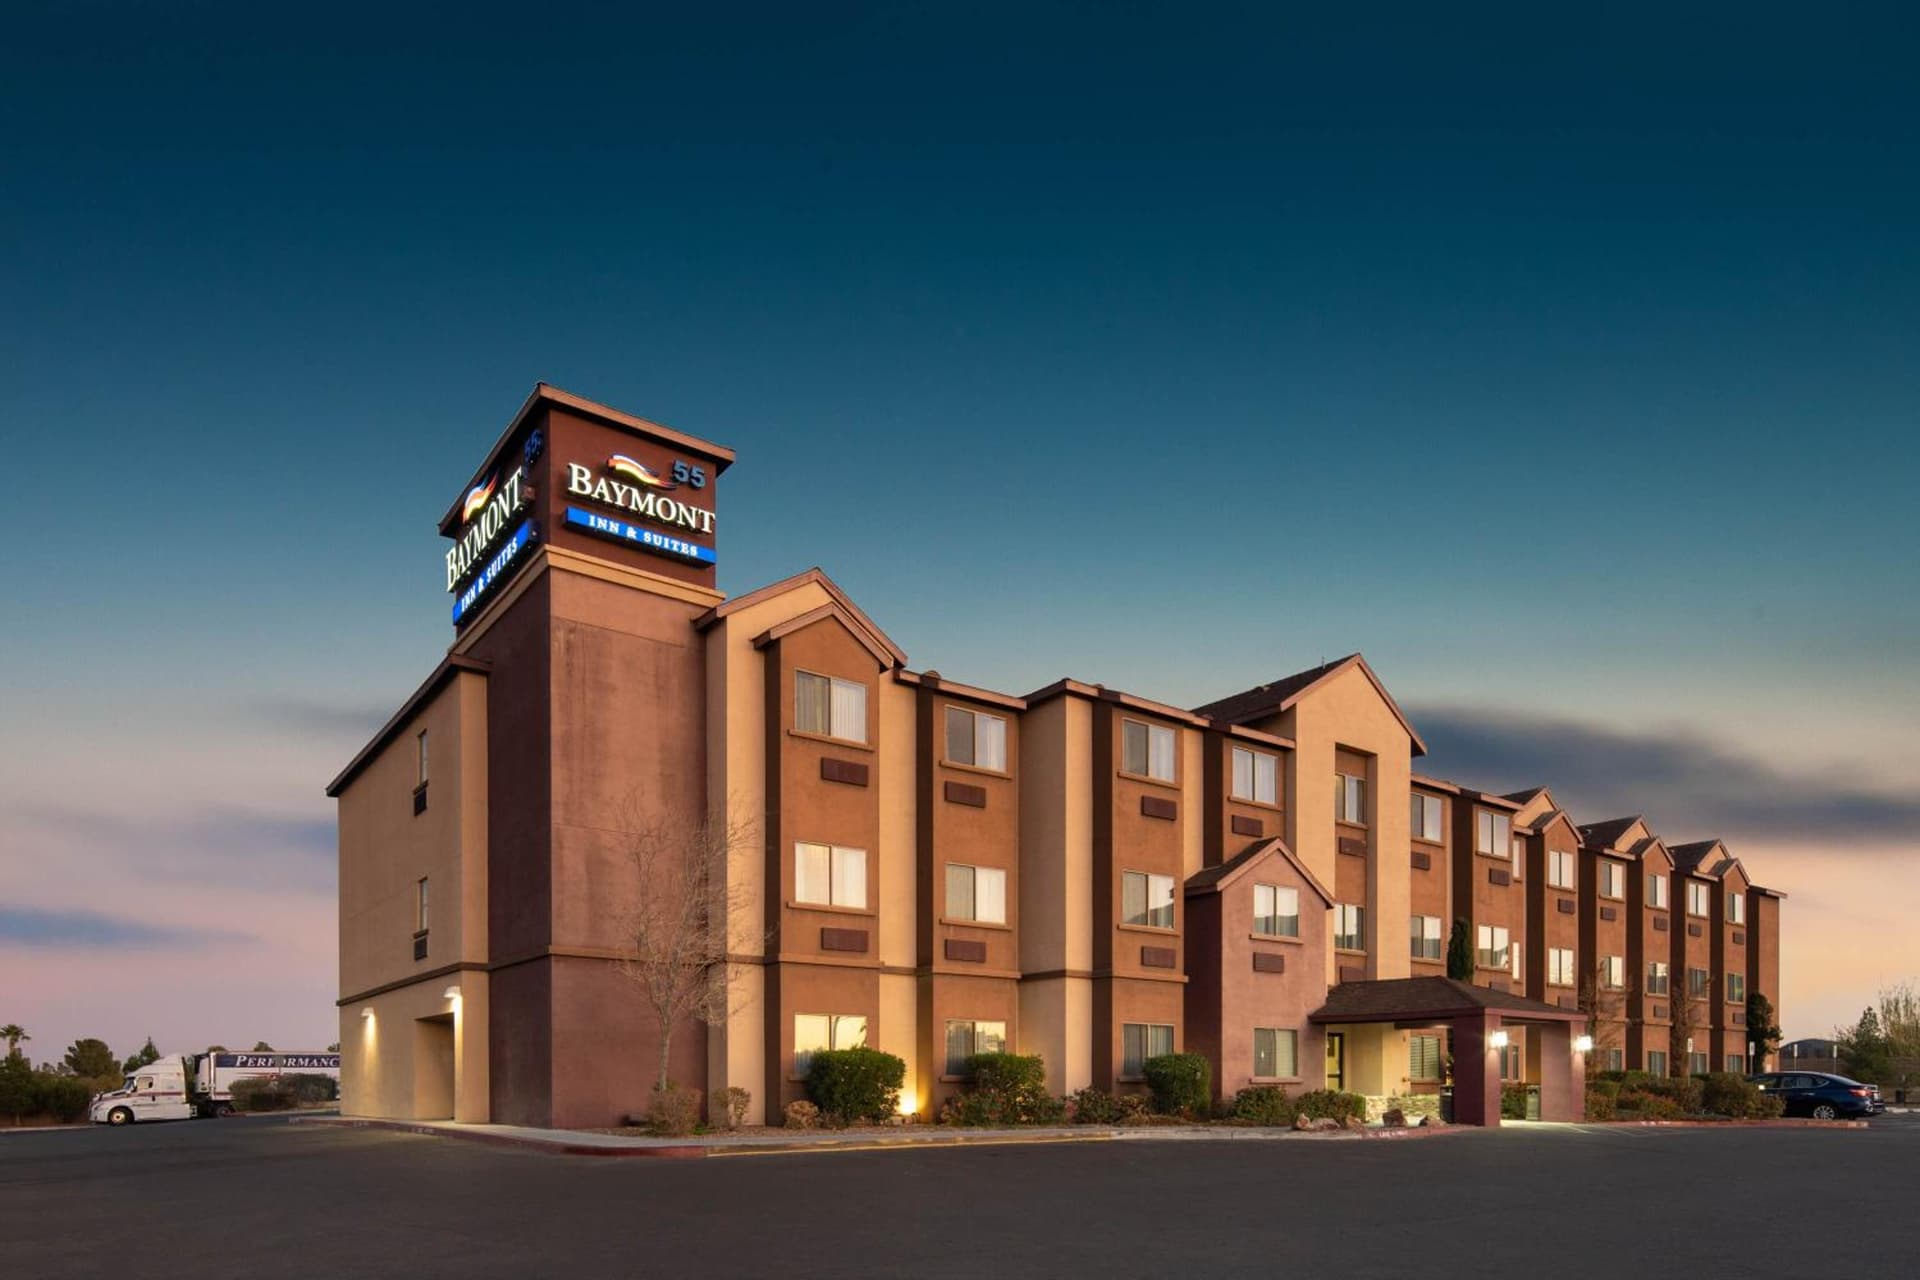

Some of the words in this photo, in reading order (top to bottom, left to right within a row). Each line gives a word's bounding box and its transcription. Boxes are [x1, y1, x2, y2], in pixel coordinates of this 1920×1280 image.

[568, 462, 716, 533] BAYMONT
[672, 460, 706, 488] 55
[446, 466, 522, 592] BAYMONT
[588, 515, 620, 534] INN
[626, 526, 637, 539] &
[643, 531, 698, 557] SUITES
[461, 585, 476, 612] INN
[486, 537, 517, 582] SUITES
[235, 1055, 339, 1067] PERFRMANC
